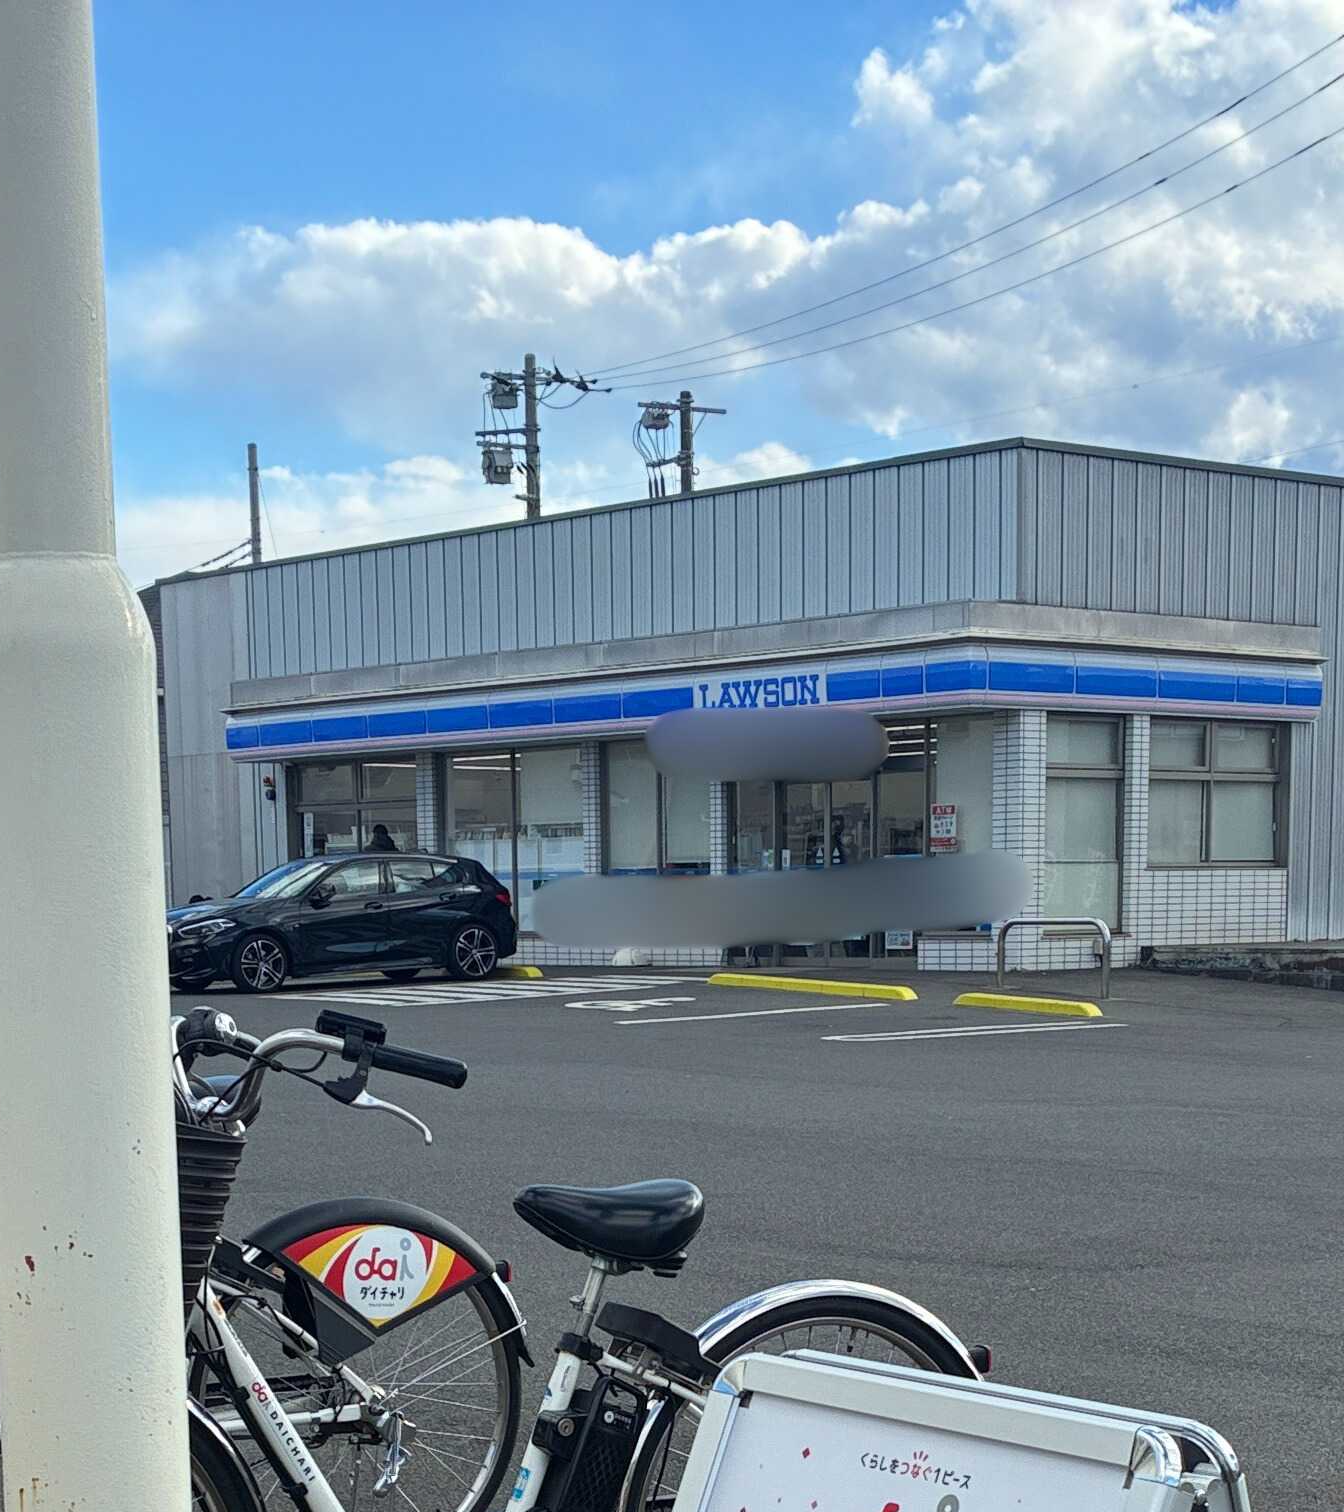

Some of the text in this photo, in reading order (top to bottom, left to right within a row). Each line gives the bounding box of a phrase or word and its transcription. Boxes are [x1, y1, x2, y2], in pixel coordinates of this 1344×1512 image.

[699, 674, 819, 708] LAWSON
[355, 1237, 415, 1281] dai
[359, 1286, 405, 1300] ダイチャリ
[270, 1411, 316, 1482] DAICHARI
[860, 1451, 973, 1490] くらしをつなぐ1ピース
